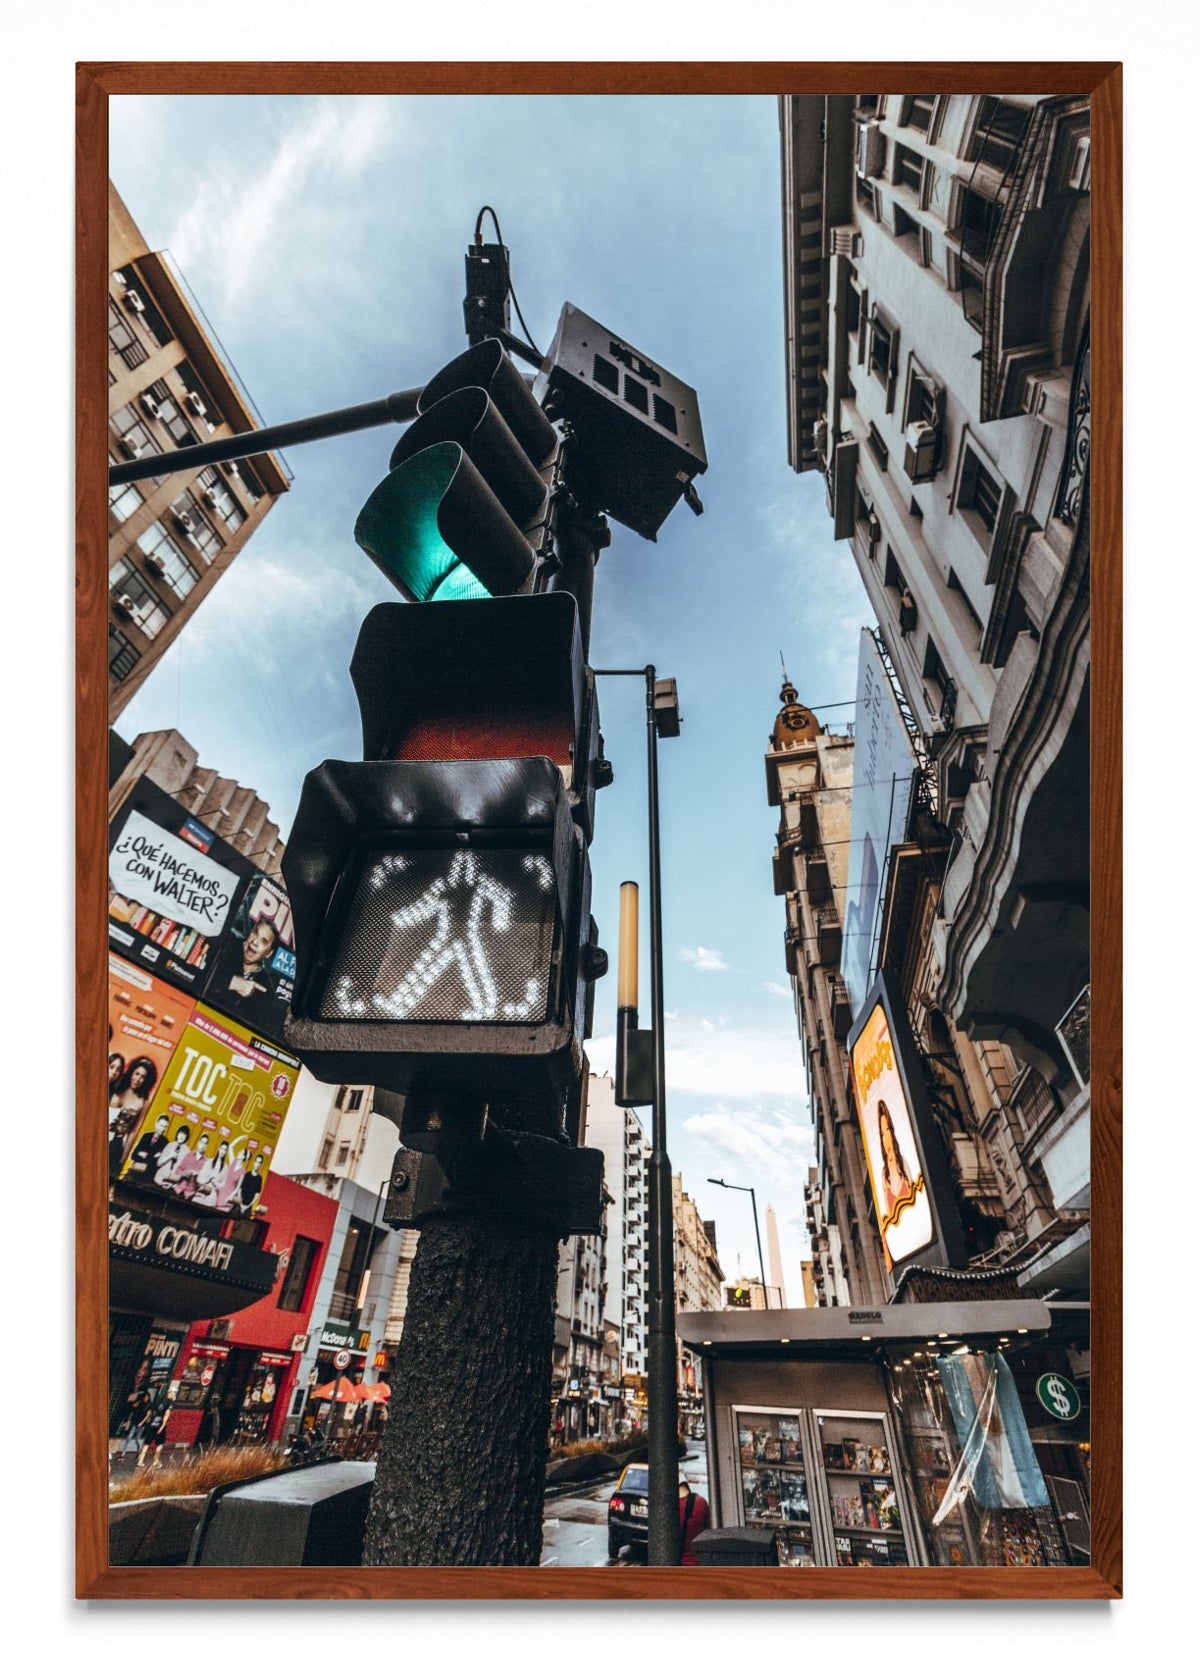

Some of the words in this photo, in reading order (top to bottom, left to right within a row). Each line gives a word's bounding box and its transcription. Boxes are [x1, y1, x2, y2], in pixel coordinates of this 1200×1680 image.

[116, 836, 164, 863] ¿QUÉ
[159, 853, 220, 898] HACEMOS
[126, 859, 156, 883] CON
[154, 877, 229, 924] WALTER?
[261, 878, 293, 907] ENRIQU
[174, 1046, 227, 1104] TOC
[216, 1072, 265, 1132] TOC
[144, 1339, 181, 1359] PINTI
[338, 1354, 348, 1364] 40
